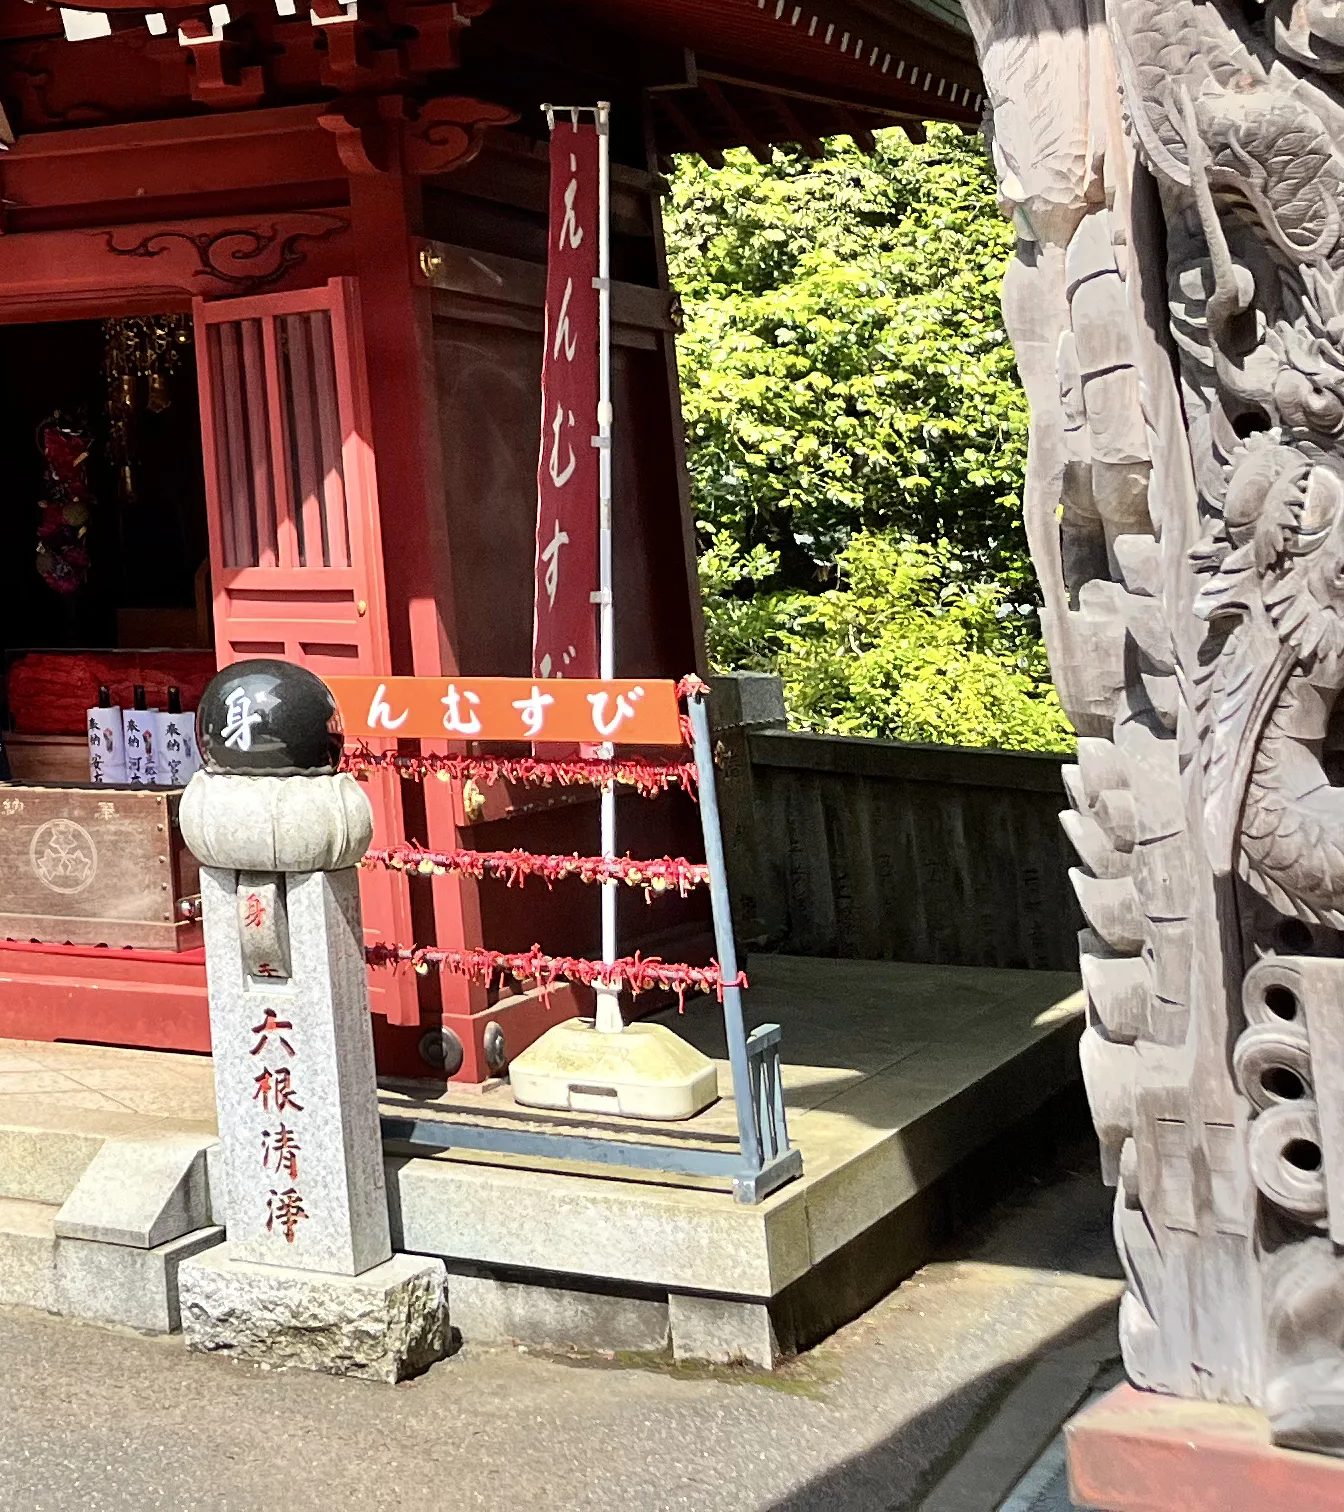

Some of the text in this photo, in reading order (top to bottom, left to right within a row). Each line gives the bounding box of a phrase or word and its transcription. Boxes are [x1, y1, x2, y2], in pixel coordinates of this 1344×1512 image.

[220, 686, 263, 751] 身
[366, 683, 646, 737] んむすび
[127, 719, 141, 748] 奉納
[165, 721, 182, 751] 奉納
